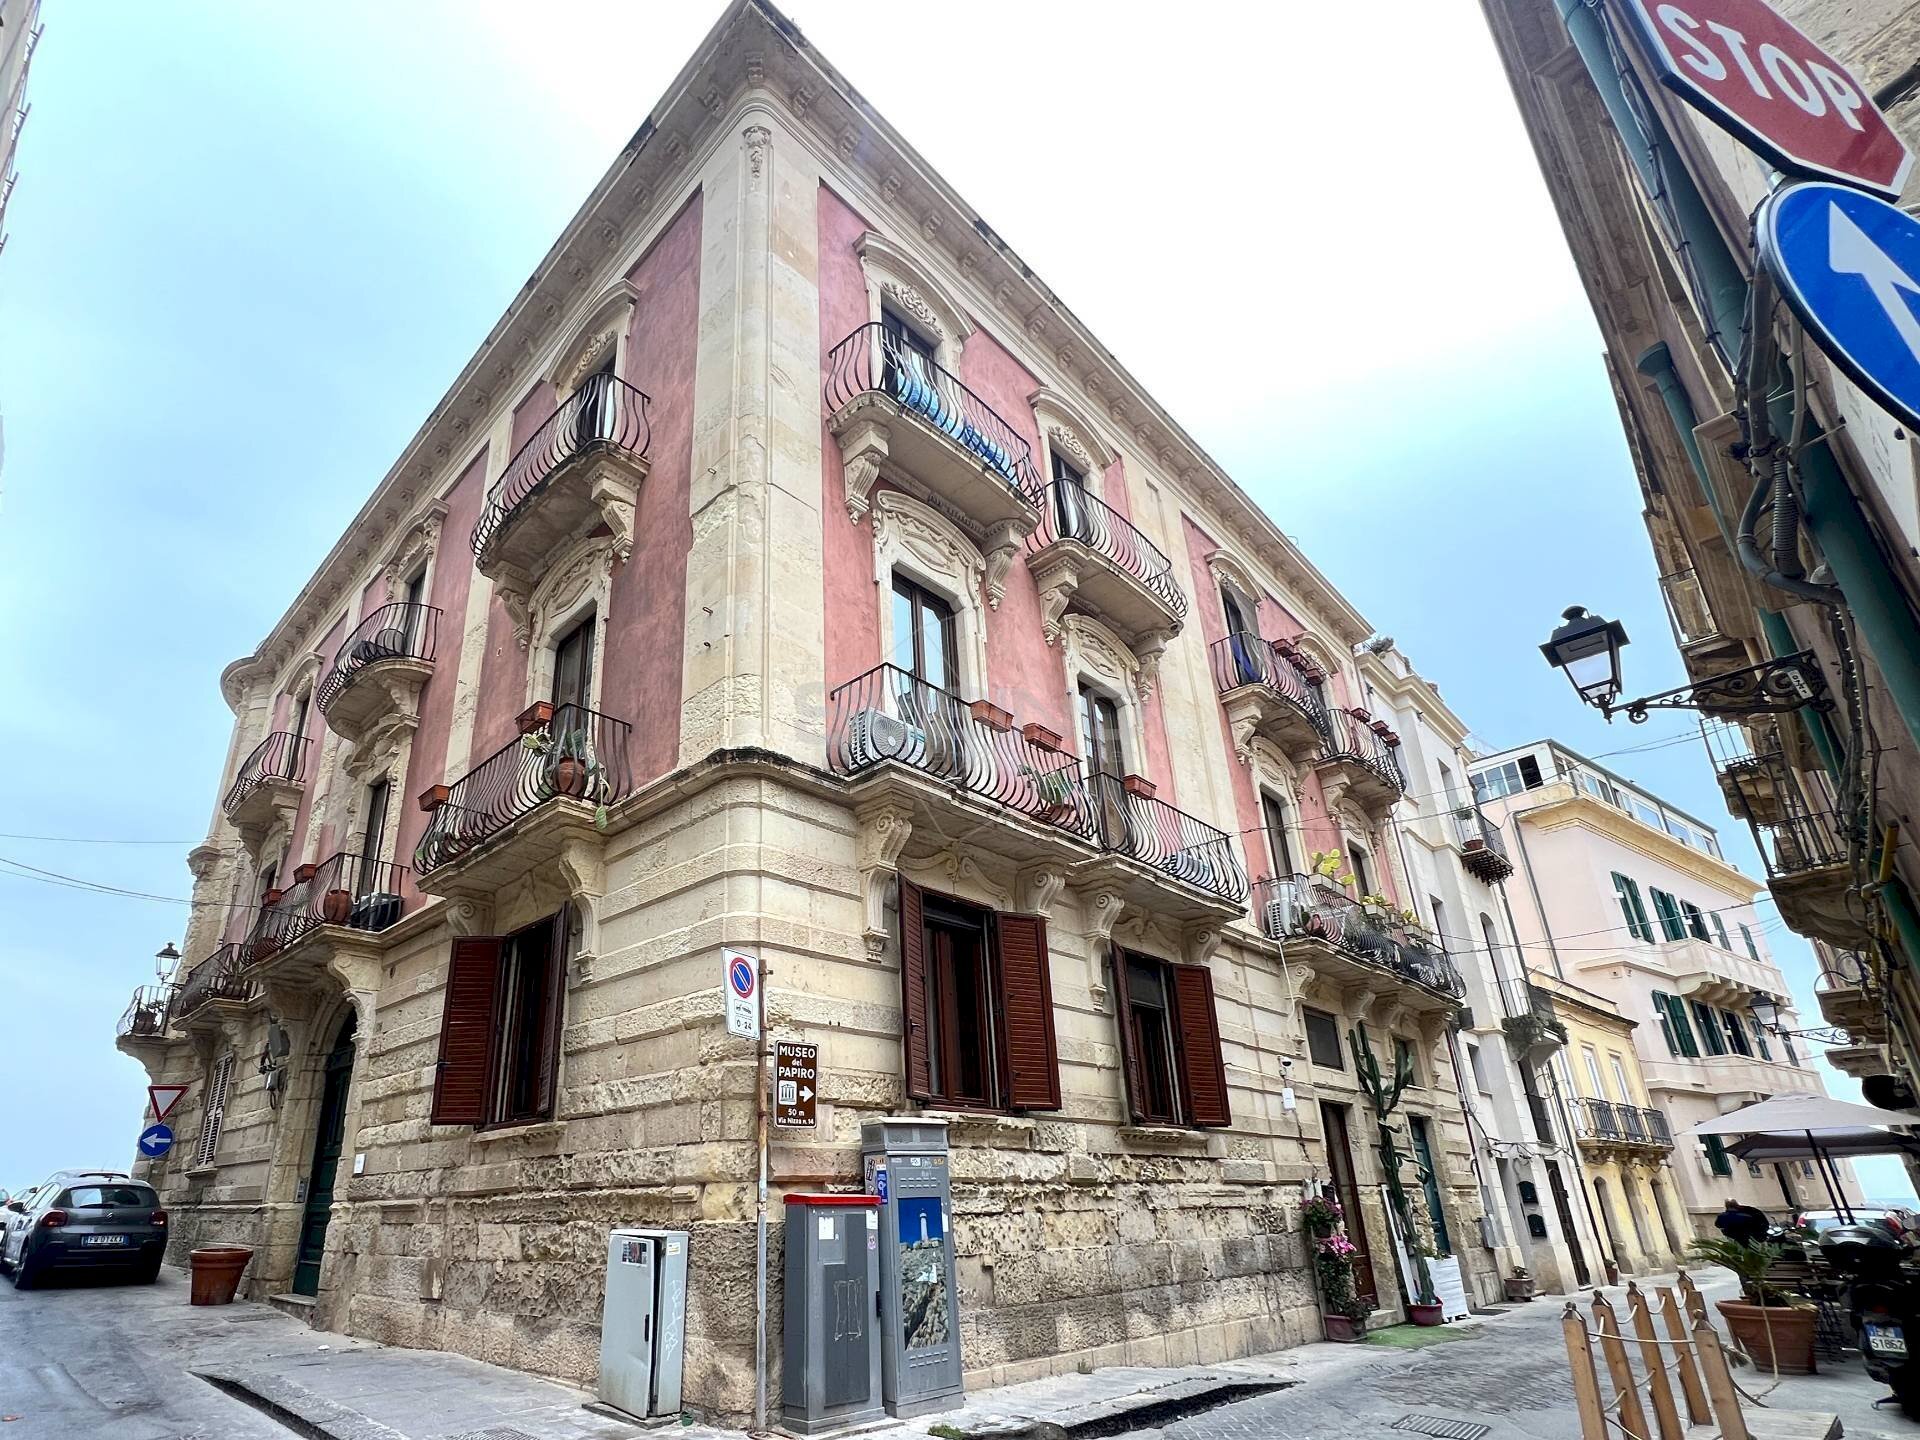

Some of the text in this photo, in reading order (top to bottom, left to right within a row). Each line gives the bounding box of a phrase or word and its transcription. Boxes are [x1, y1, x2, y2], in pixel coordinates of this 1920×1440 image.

[1657, 4, 1865, 132] STOP
[779, 1045, 816, 1059] MUSEO
[791, 1058, 803, 1067] del
[778, 1066, 815, 1080] PAPIRO
[788, 1108, 797, 1116] 50
[778, 1116, 787, 1124] Via
